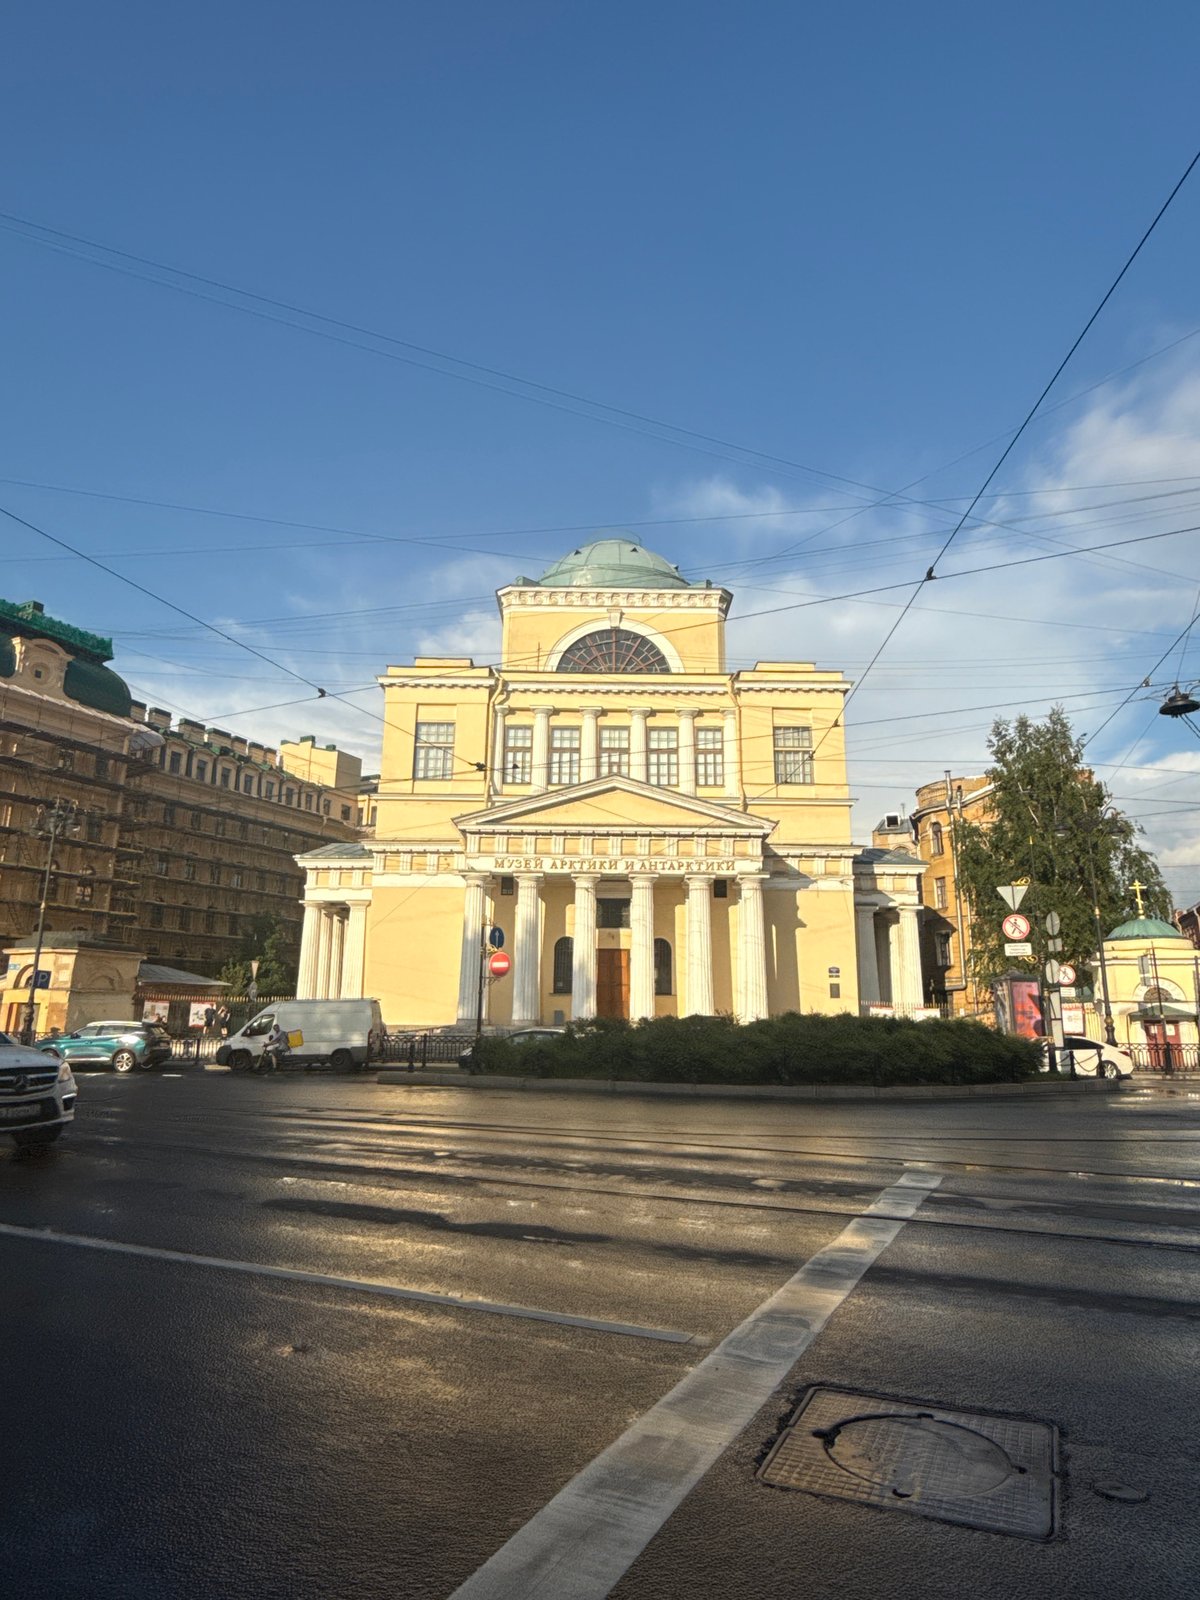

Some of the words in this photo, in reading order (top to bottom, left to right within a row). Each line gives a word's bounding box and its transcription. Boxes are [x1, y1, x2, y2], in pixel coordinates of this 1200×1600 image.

[494, 858, 543, 869] МУЗЕЙ
[550, 859, 618, 870] АРКТИКИ
[625, 860, 634, 871] И
[639, 860, 736, 871] АНТАРКТИКИ
